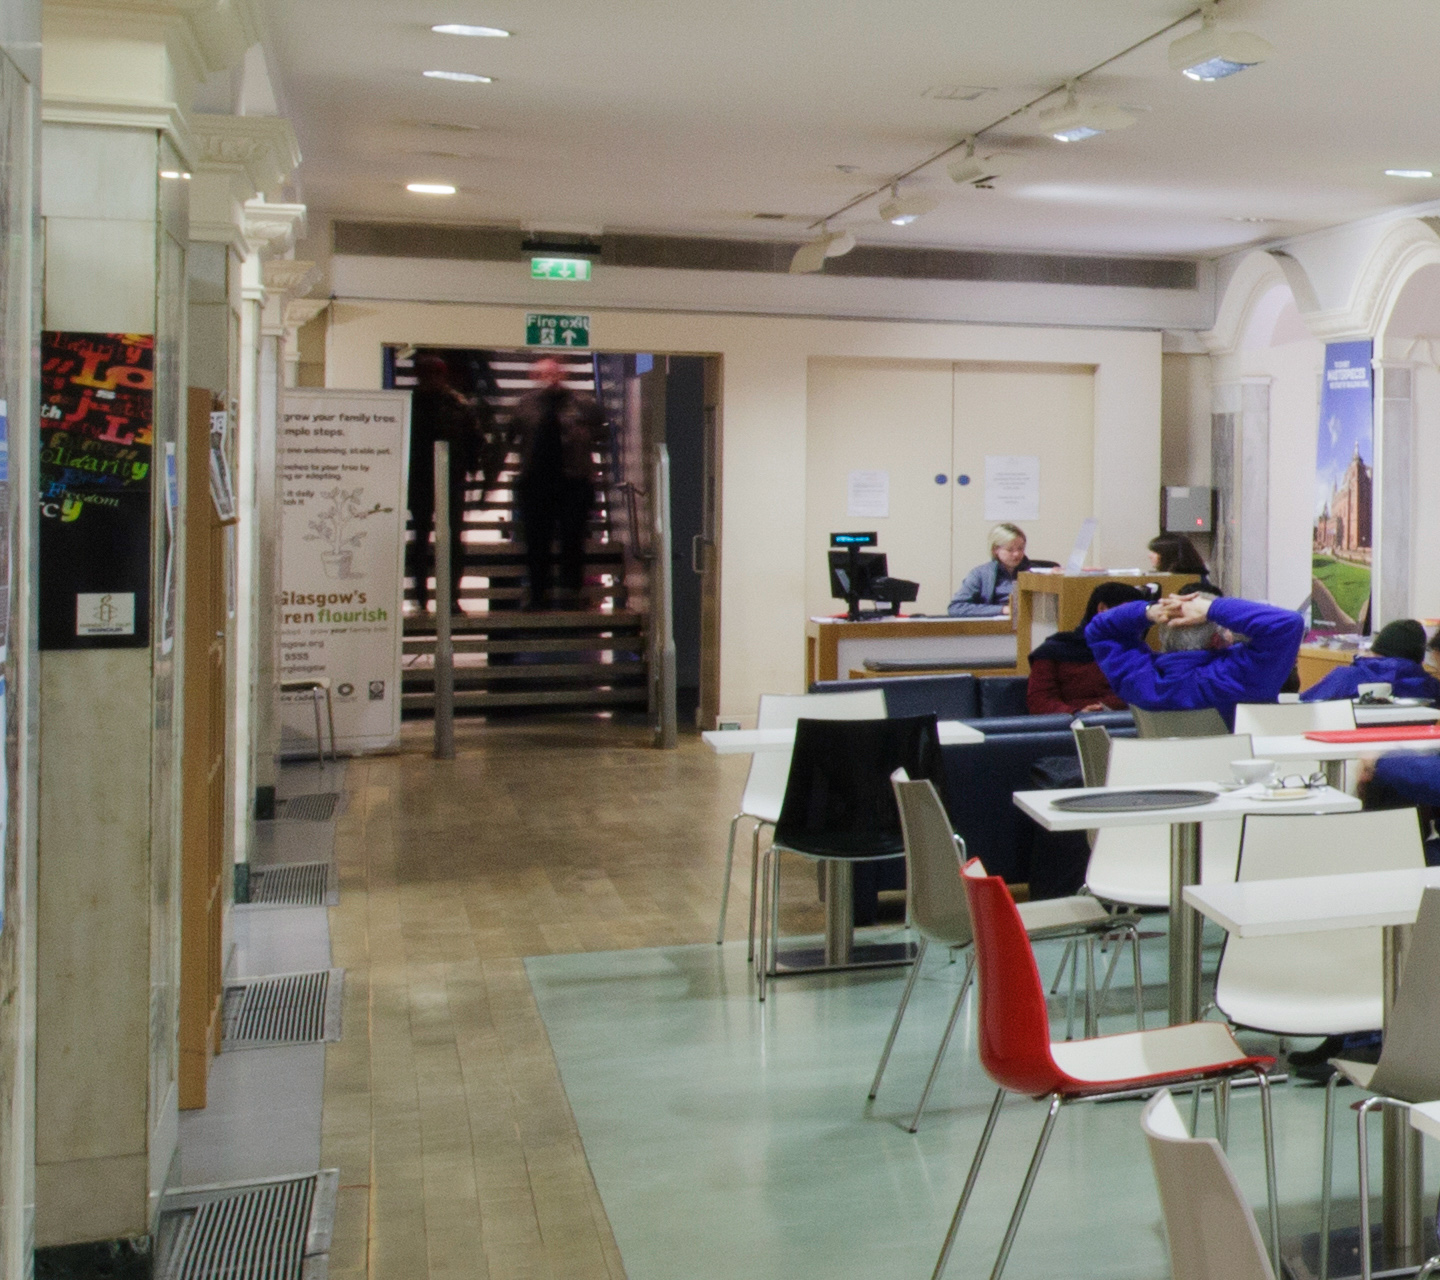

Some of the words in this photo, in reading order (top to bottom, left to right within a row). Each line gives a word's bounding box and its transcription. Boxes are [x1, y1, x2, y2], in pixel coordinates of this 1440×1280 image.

[528, 315, 556, 327] Fire
[560, 317, 589, 330] exit
[339, 414, 370, 423] family
[318, 608, 387, 622] flourish
